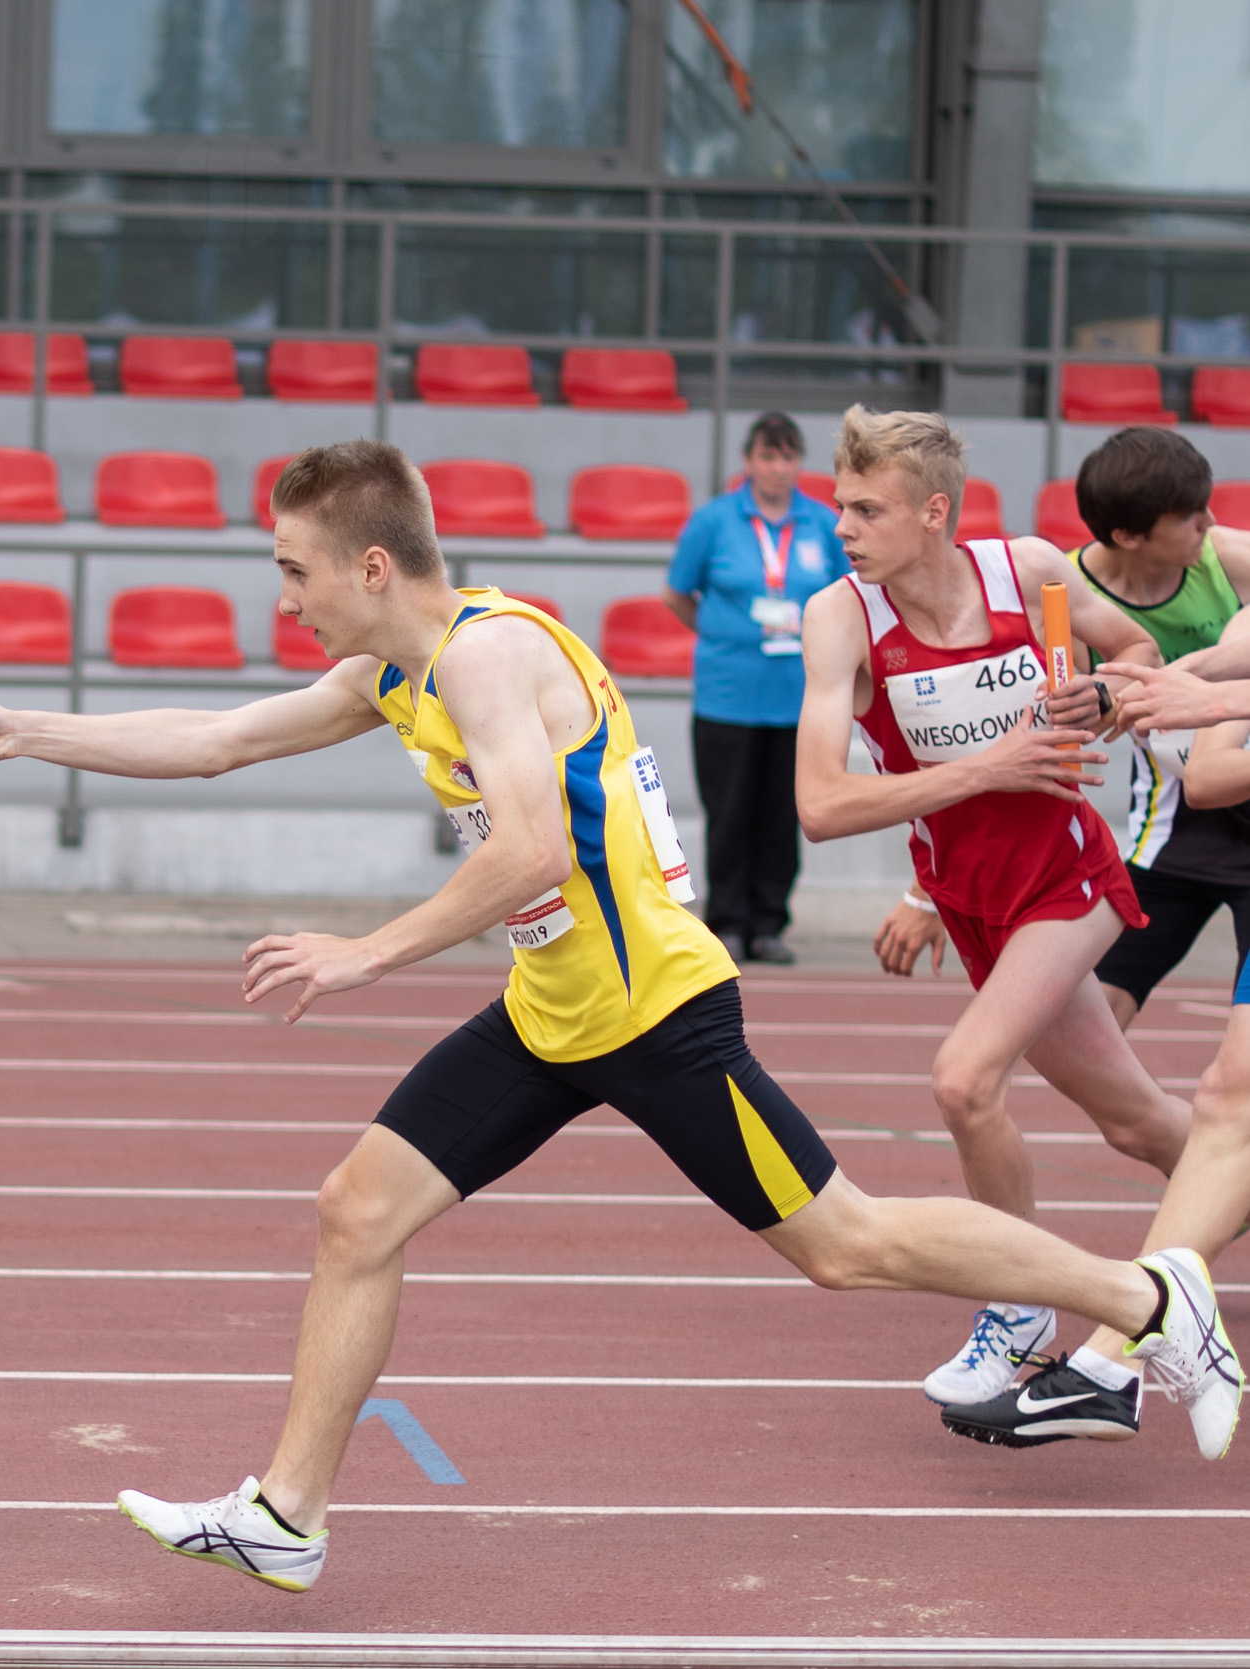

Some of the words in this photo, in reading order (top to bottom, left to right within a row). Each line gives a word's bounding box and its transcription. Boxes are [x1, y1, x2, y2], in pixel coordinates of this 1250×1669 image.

[975, 653, 1036, 692] 466
[907, 703, 1050, 747] WESOŁOWK
[468, 808, 492, 841] 33
